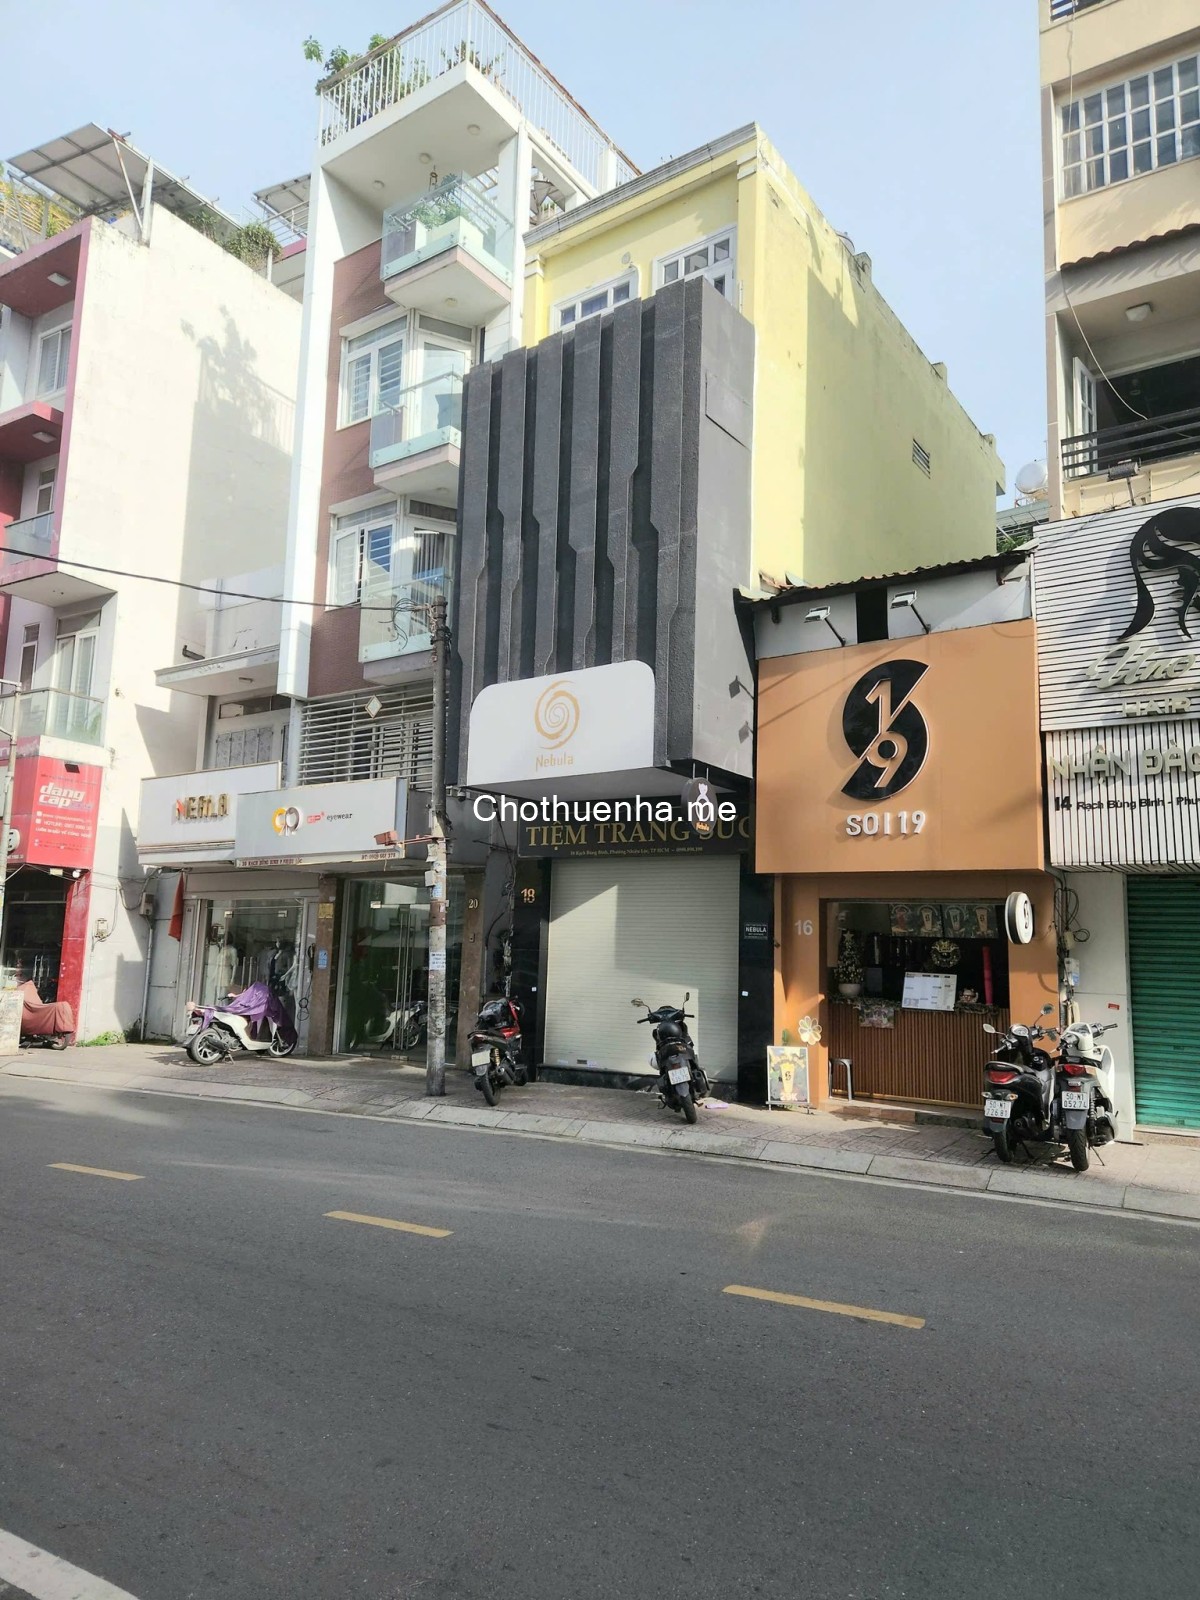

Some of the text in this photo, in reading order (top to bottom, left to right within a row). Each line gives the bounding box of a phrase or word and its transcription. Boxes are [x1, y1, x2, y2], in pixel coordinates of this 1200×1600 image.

[1122, 696, 1192, 717] HAIR
[535, 752, 574, 772] Nebula
[1054, 795, 1072, 811] 14
[326, 813, 353, 822] eyewear
[525, 820, 588, 851] TIỆM
[593, 819, 690, 845] TRANG
[468, 898, 478, 909] 20
[521, 888, 536, 904] 18
[794, 919, 813, 936] 16
